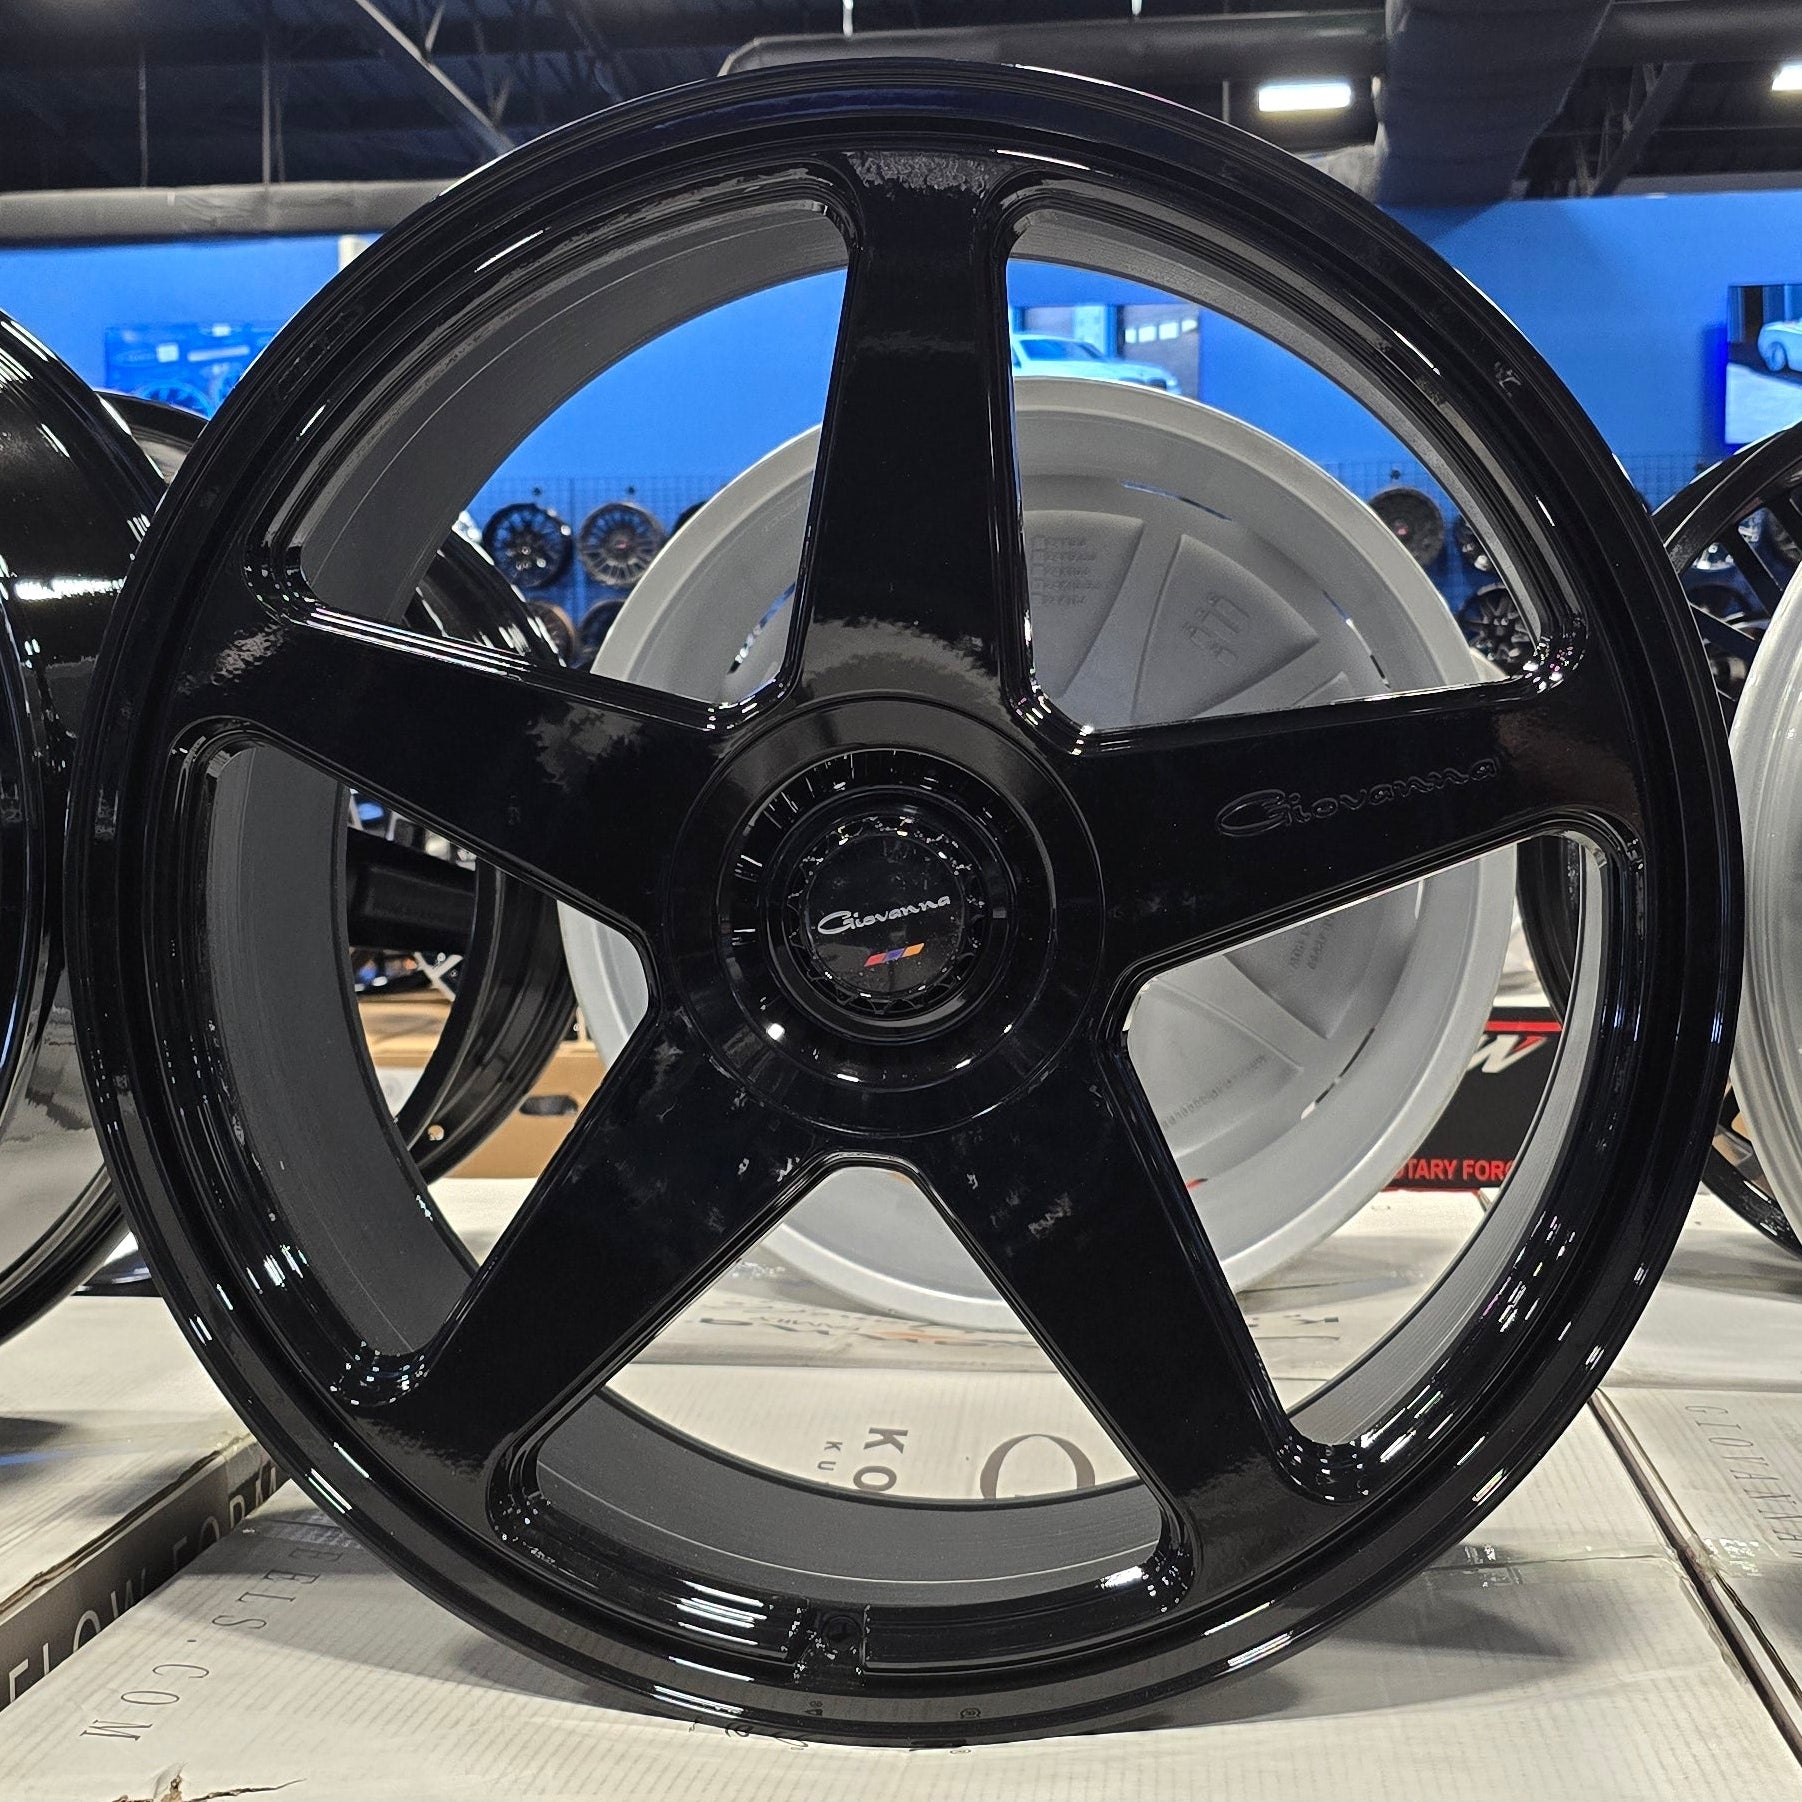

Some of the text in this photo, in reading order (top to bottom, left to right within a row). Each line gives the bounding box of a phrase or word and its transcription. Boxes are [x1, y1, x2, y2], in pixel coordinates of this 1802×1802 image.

[1215, 758, 1498, 837] Giovanna
[817, 895, 951, 935] Giovanna
[1684, 1405, 1802, 1558] GIOVANNA
